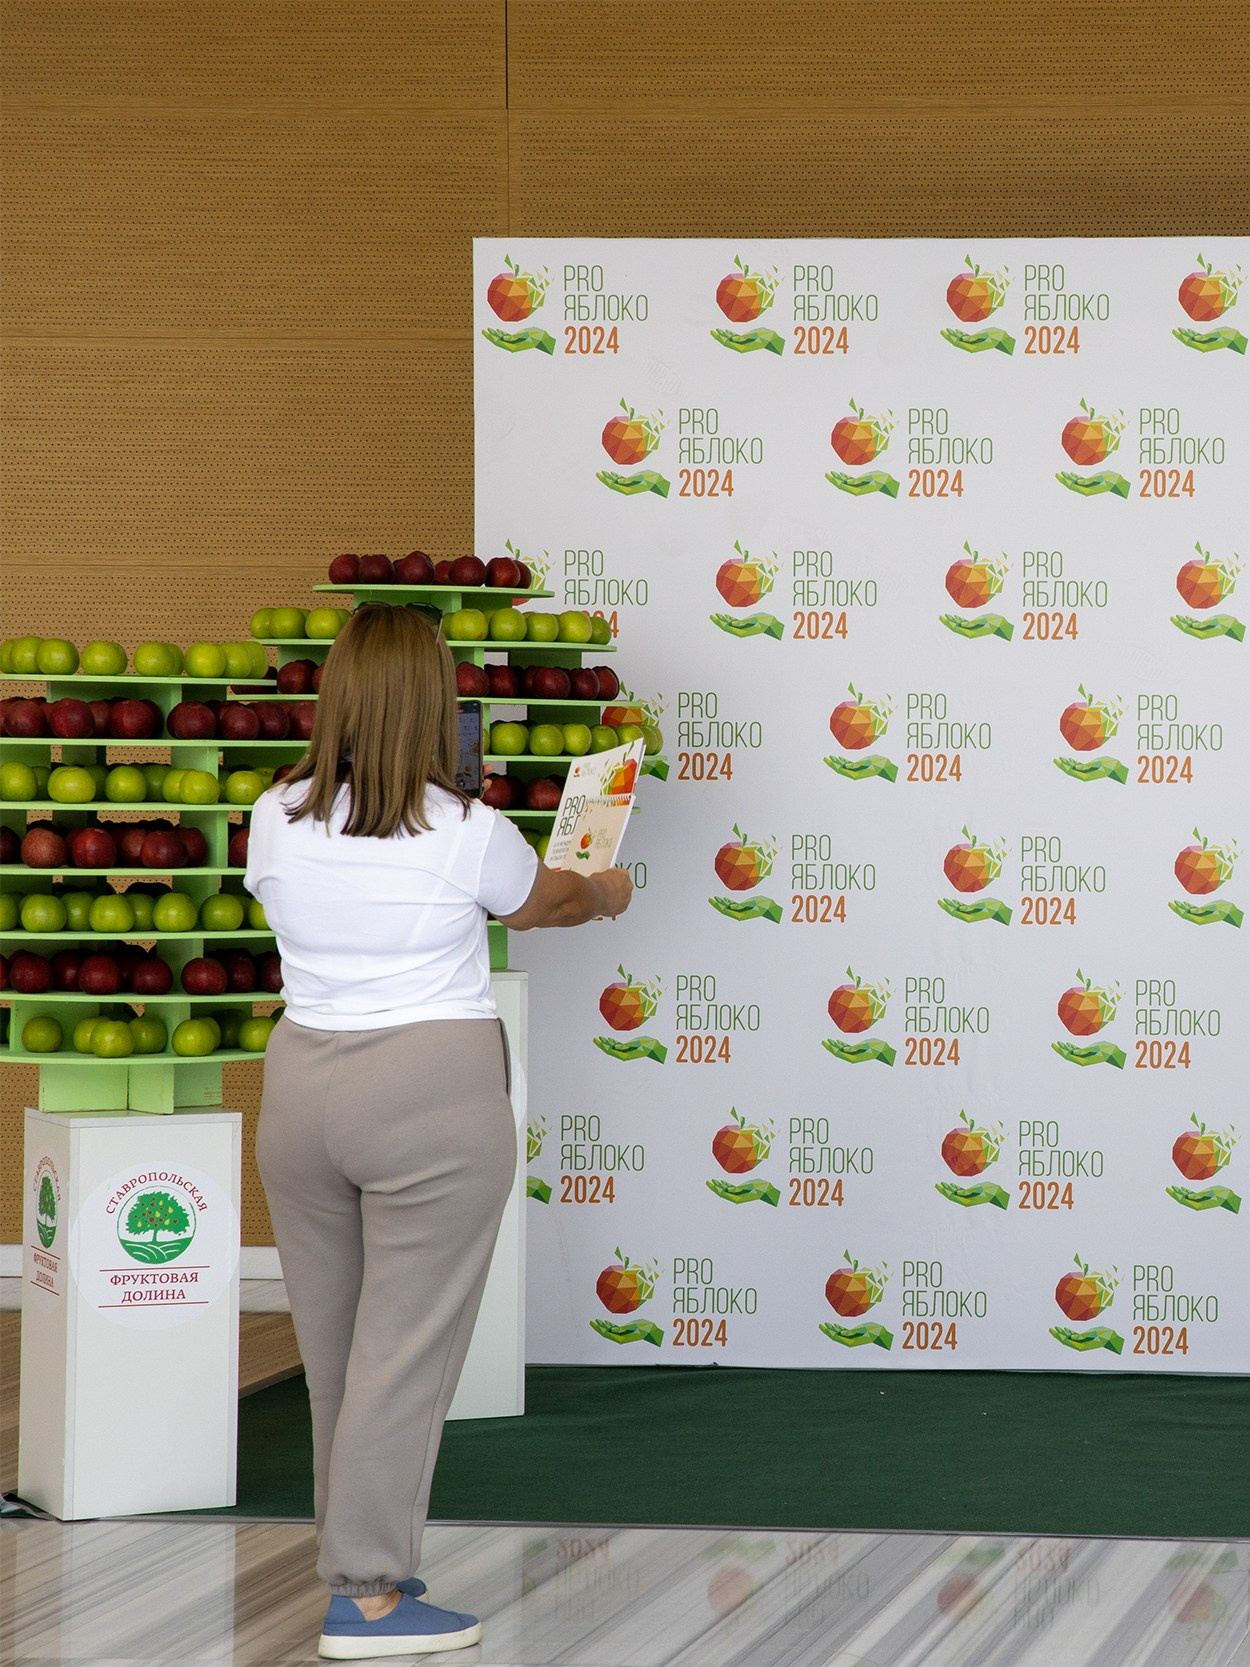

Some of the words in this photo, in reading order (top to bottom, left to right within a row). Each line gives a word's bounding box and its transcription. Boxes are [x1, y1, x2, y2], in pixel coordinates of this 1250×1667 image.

[563, 264, 604, 293] PRO
[793, 264, 834, 293] PRO
[1024, 263, 1065, 292] PRO
[563, 294, 649, 322] ЯБЛОКО
[793, 294, 879, 322] ЯБЛОКО
[1024, 293, 1110, 322] ЯБЛОКО
[563, 324, 620, 355] 2024
[793, 325, 850, 356] 2024
[1023, 325, 1081, 355] 2024
[678, 407, 719, 436] PRO
[908, 407, 949, 436] PRO
[1139, 407, 1180, 436] PRO
[678, 437, 763, 465] ЯБЛОКО
[908, 437, 993, 465] ЯБЛОКО
[1139, 437, 1225, 465] ЯБЛОКО
[678, 468, 735, 498] 2024
[908, 468, 964, 499] 2024
[1138, 468, 1196, 499] 2024
[564, 549, 604, 577] PRO
[792, 550, 833, 578] PRO
[1022, 550, 1063, 579] PRO
[564, 578, 649, 607] ЯБЛОКО
[792, 579, 878, 607] ЯБЛОКО
[1022, 580, 1108, 608] ЯБЛОКО
[792, 610, 849, 641] 2024
[1022, 611, 1079, 641] 2024
[677, 691, 718, 720] PRO
[906, 692, 947, 721] PRO
[1137, 694, 1178, 722] PRO
[677, 720, 762, 749] ЯБЛОКО
[906, 722, 992, 750] ЯБЛОКО
[1137, 723, 1223, 752] ЯБЛОКО
[677, 751, 734, 782] 2024
[906, 753, 963, 783] 2024
[1136, 754, 1194, 785] 2024
[562, 795, 586, 816] PRO
[791, 834, 832, 862] PRO
[1021, 835, 1062, 864] PRO
[791, 863, 876, 891] ЯБЛОКО
[1020, 865, 1106, 893] ЯБЛОКО
[791, 894, 847, 924] 2024
[1020, 896, 1077, 926] 2024
[676, 974, 717, 1002] PRO
[905, 976, 945, 1005] PRO
[1135, 979, 1176, 1007] PRO
[675, 1003, 761, 1032] ЯБЛОКО
[904, 1005, 990, 1034] ЯБЛОКО
[1135, 1008, 1221, 1037] ЯБЛОКО
[675, 1034, 732, 1064] 2024
[904, 1036, 961, 1067] 2024
[1134, 1039, 1192, 1070] 2024
[560, 1114, 601, 1142] PRO
[789, 1117, 830, 1145] PRO
[1018, 1120, 1059, 1148] PRO
[560, 1143, 645, 1172] ЯБЛОКО
[788, 1146, 874, 1175] ЯБЛОКО
[1018, 1149, 1104, 1178] ЯБЛОКО
[105, 1171, 208, 1215] СТАВРОПОЛЬСКАЯ
[559, 1174, 616, 1205] 2024
[788, 1177, 845, 1208] 2024
[1018, 1180, 1075, 1211] 2024
[110, 1271, 199, 1286] ФРУКТОВАЯ
[673, 1257, 714, 1286] PRO
[902, 1260, 943, 1289] PRO
[1133, 1264, 1174, 1293] PRO
[121, 1288, 186, 1304] ДОЛИНА
[672, 1286, 758, 1315] ЯБЛОКО
[901, 1289, 987, 1319] ЯБЛОКО
[1132, 1293, 1219, 1323] ЯБЛОКО
[672, 1317, 729, 1348] 2024
[901, 1320, 958, 1352] 2024
[1132, 1325, 1190, 1356] 2024
